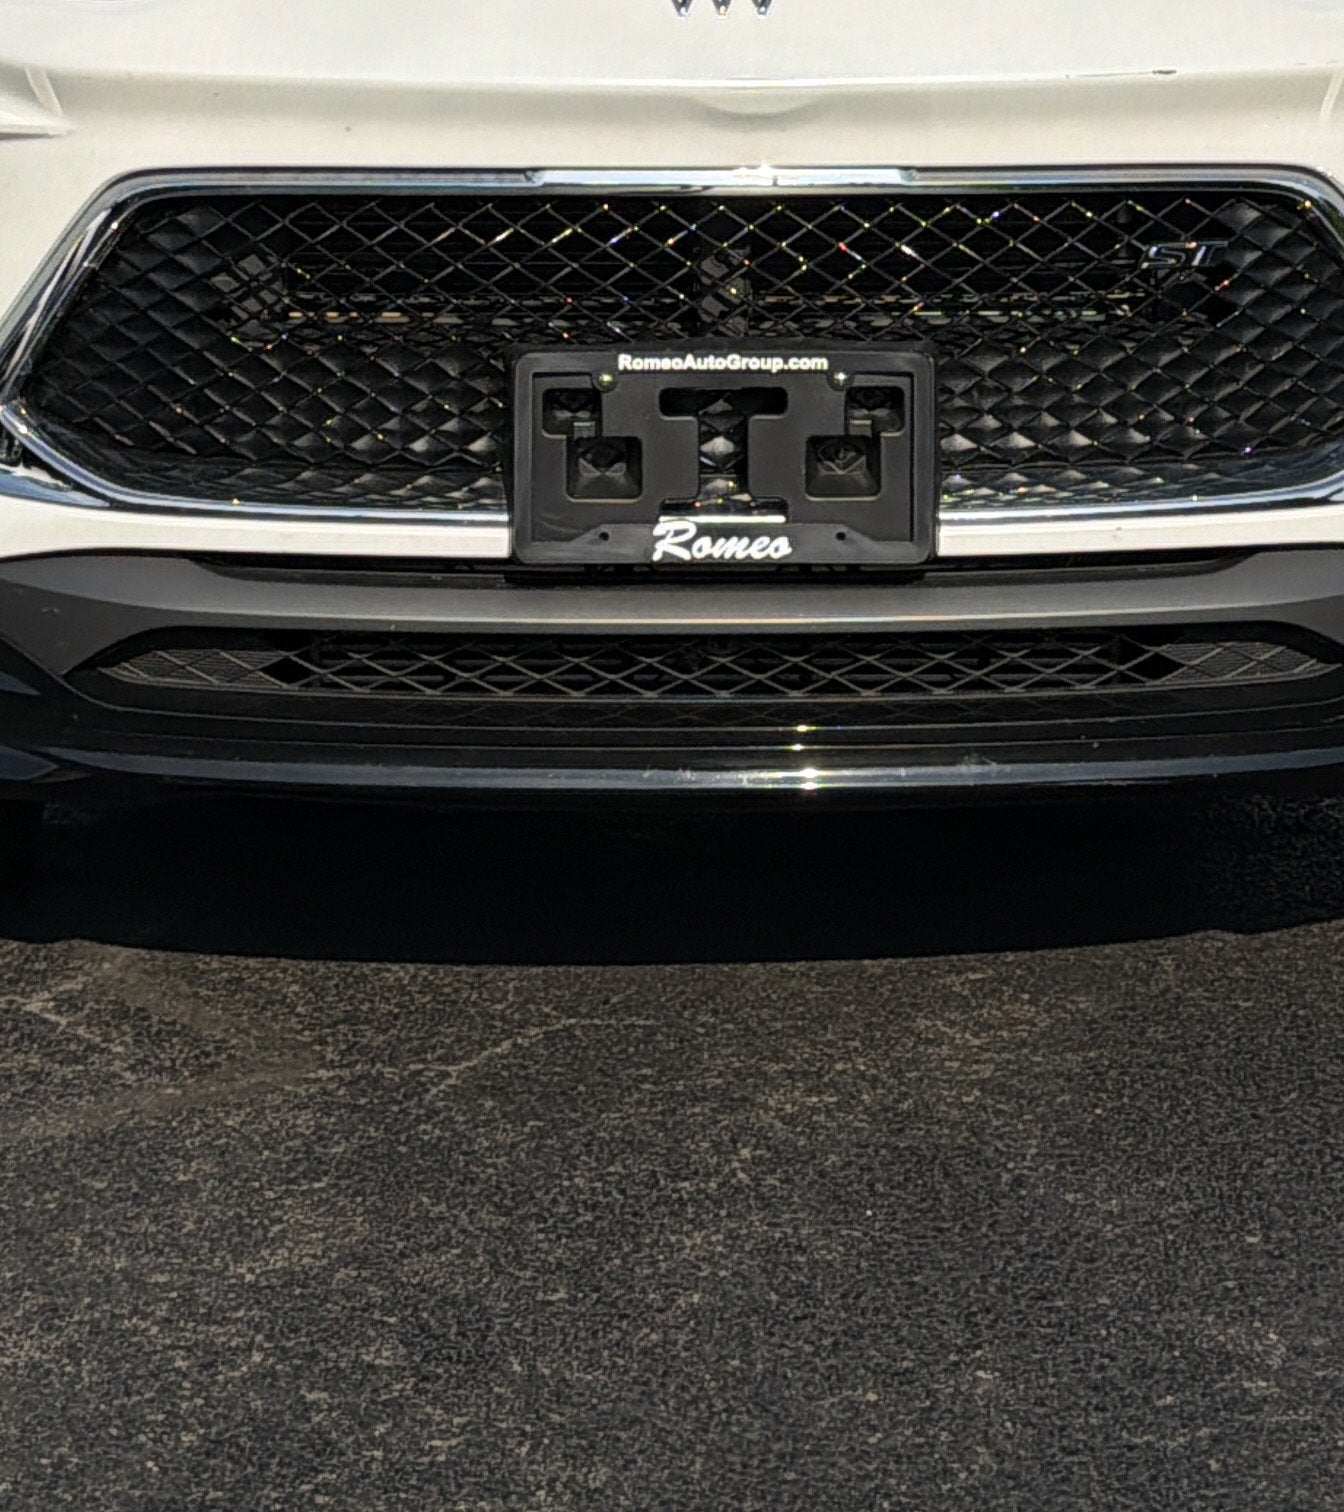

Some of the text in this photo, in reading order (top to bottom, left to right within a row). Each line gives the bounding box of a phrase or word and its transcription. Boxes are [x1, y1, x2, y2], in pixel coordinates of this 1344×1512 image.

[1140, 240, 1230, 270] ST
[617, 353, 829, 373] RomeoAutoGroup.com
[651, 519, 793, 562] Romeo
